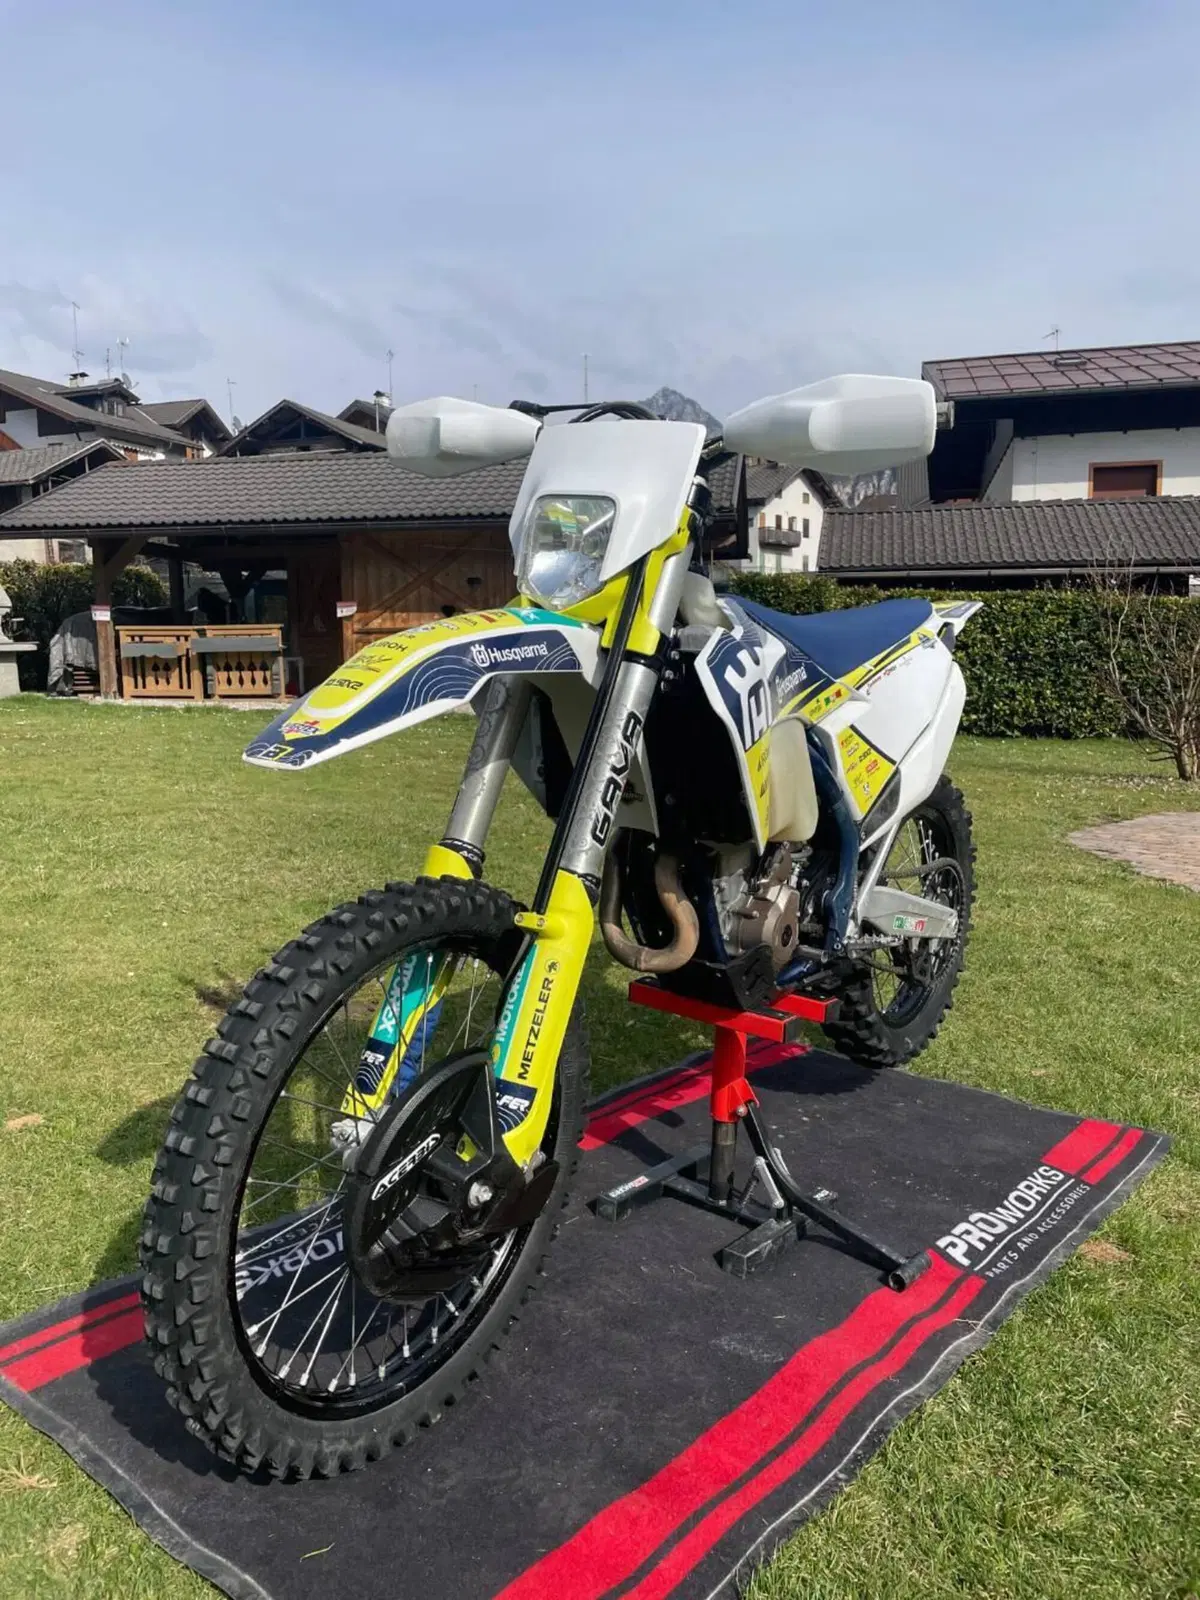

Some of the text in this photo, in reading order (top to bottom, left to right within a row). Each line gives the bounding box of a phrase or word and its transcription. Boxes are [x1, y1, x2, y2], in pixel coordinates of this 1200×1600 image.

[489, 642, 547, 663] Husqvarna
[591, 711, 643, 848] GAVA
[517, 978, 554, 1080] METZELER
[935, 1166, 1065, 1267] PROWORKS
[985, 1183, 1091, 1278] PARTS AND ACCESSORIES
